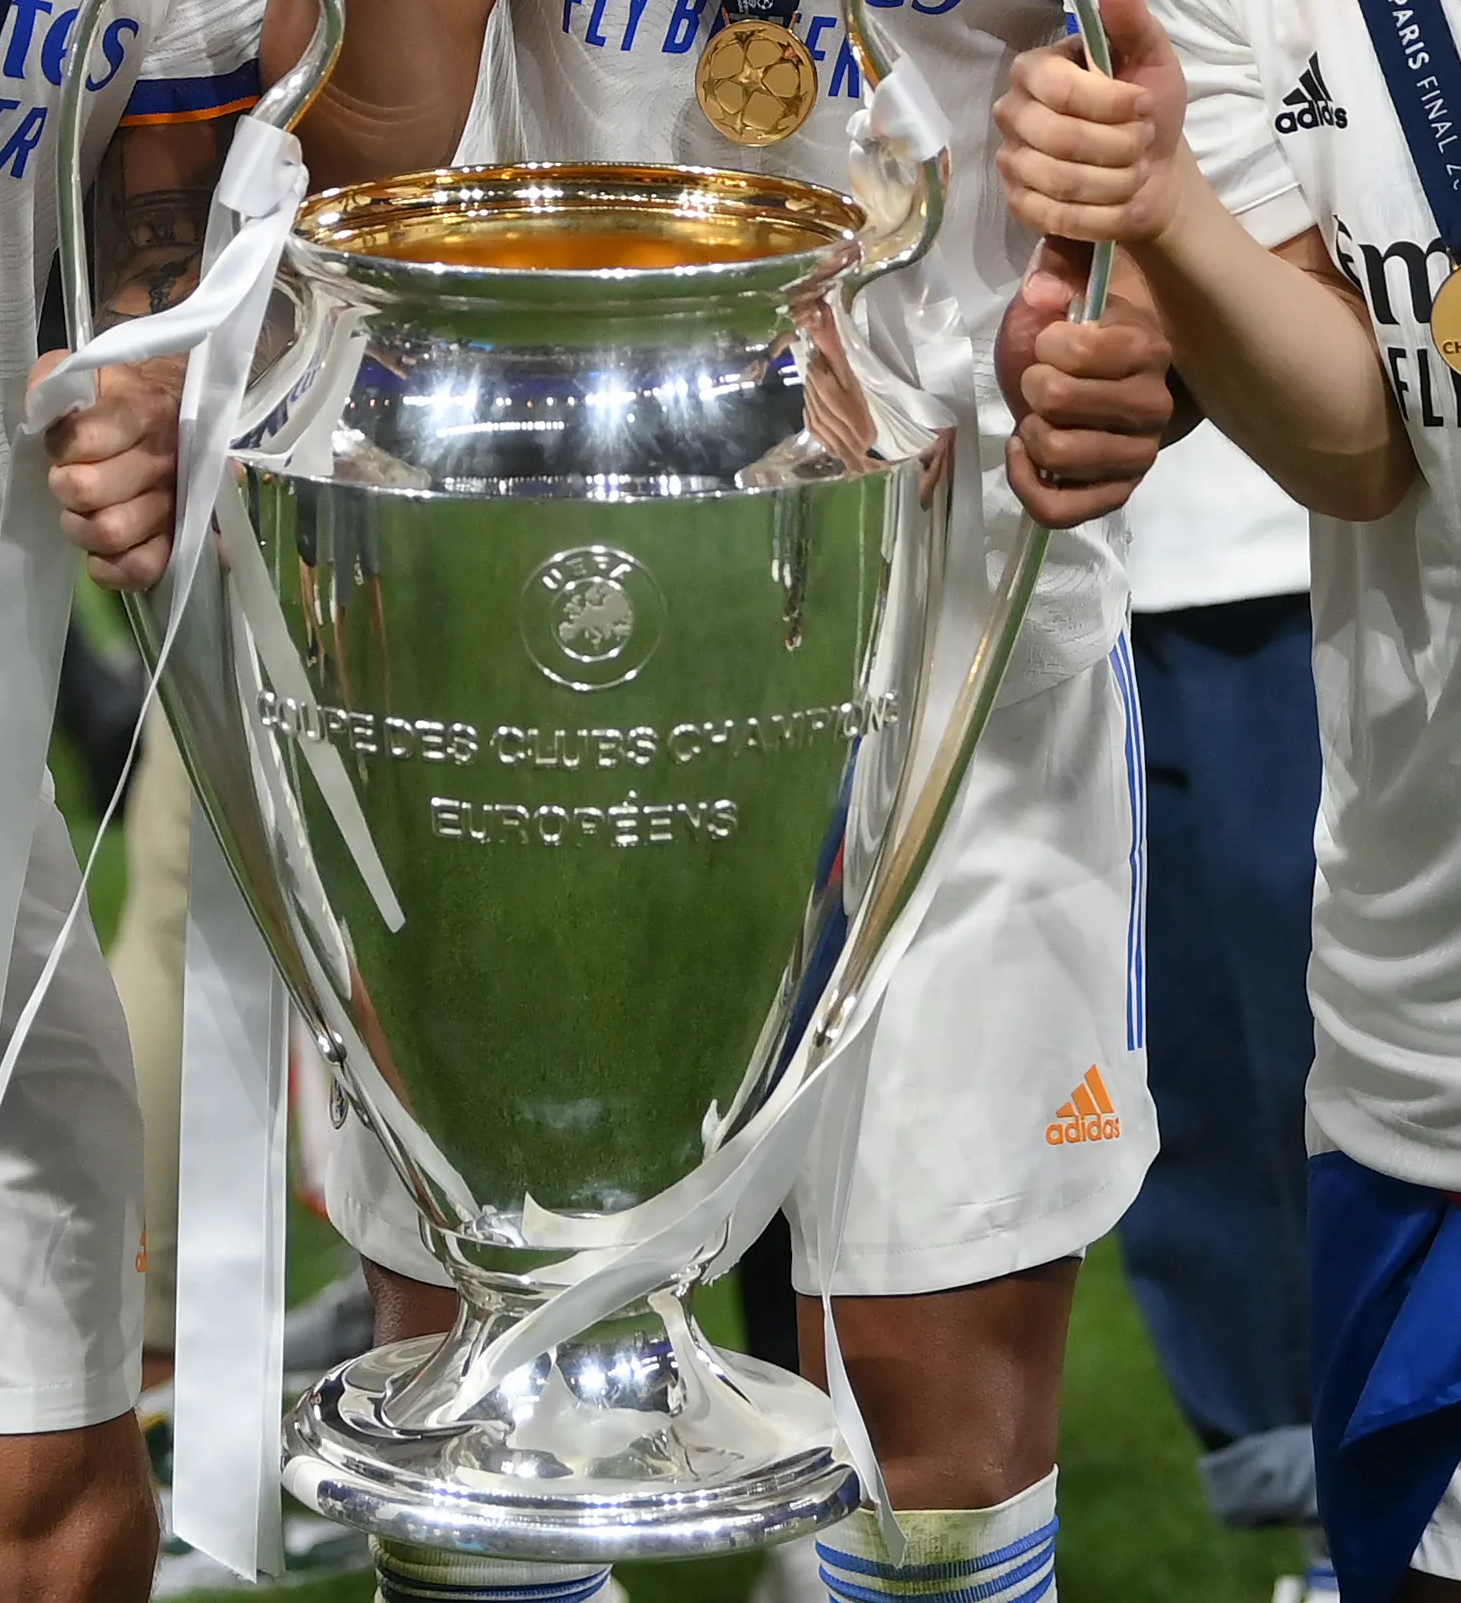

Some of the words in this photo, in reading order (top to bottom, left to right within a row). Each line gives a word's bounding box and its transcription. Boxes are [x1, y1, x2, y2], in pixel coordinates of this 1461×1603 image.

[1416, 75, 1458, 154] FINAL
[255, 689, 378, 755] COUPE
[383, 715, 479, 767] DES
[490, 723, 661, 769] CLUBS
[667, 690, 901, 766] CHAMPIONS
[429, 789, 740, 848] EUROPÉENS
[1045, 1113, 1121, 1145] adidas
